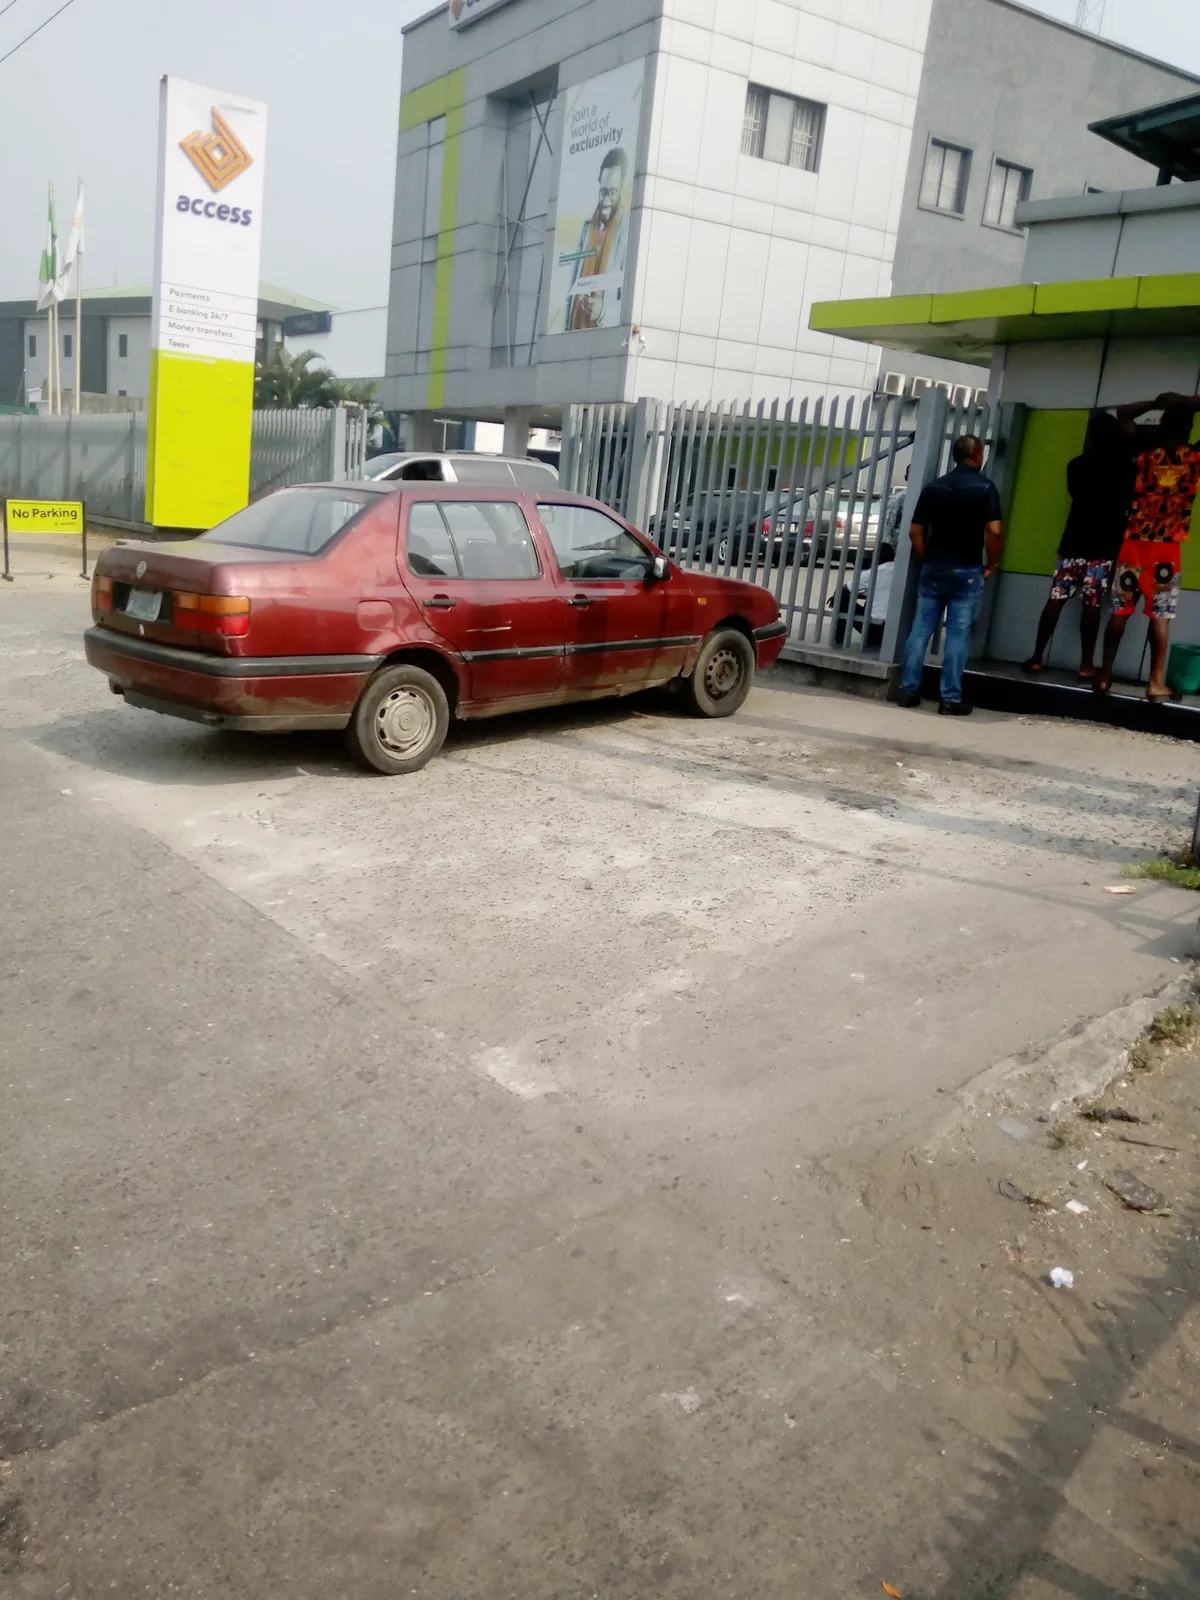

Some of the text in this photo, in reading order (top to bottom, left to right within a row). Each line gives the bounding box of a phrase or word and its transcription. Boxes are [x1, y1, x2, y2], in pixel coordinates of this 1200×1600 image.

[571, 105, 597, 128] join a
[571, 111, 611, 139] world of
[569, 127, 624, 155] exclusivity
[176, 194, 253, 227] access
[169, 288, 210, 302] Payments
[168, 305, 229, 321] E banking 24/7
[168, 321, 233, 339] Money transfers
[168, 338, 190, 349] Taxes
[12, 508, 77, 520] No Parking
